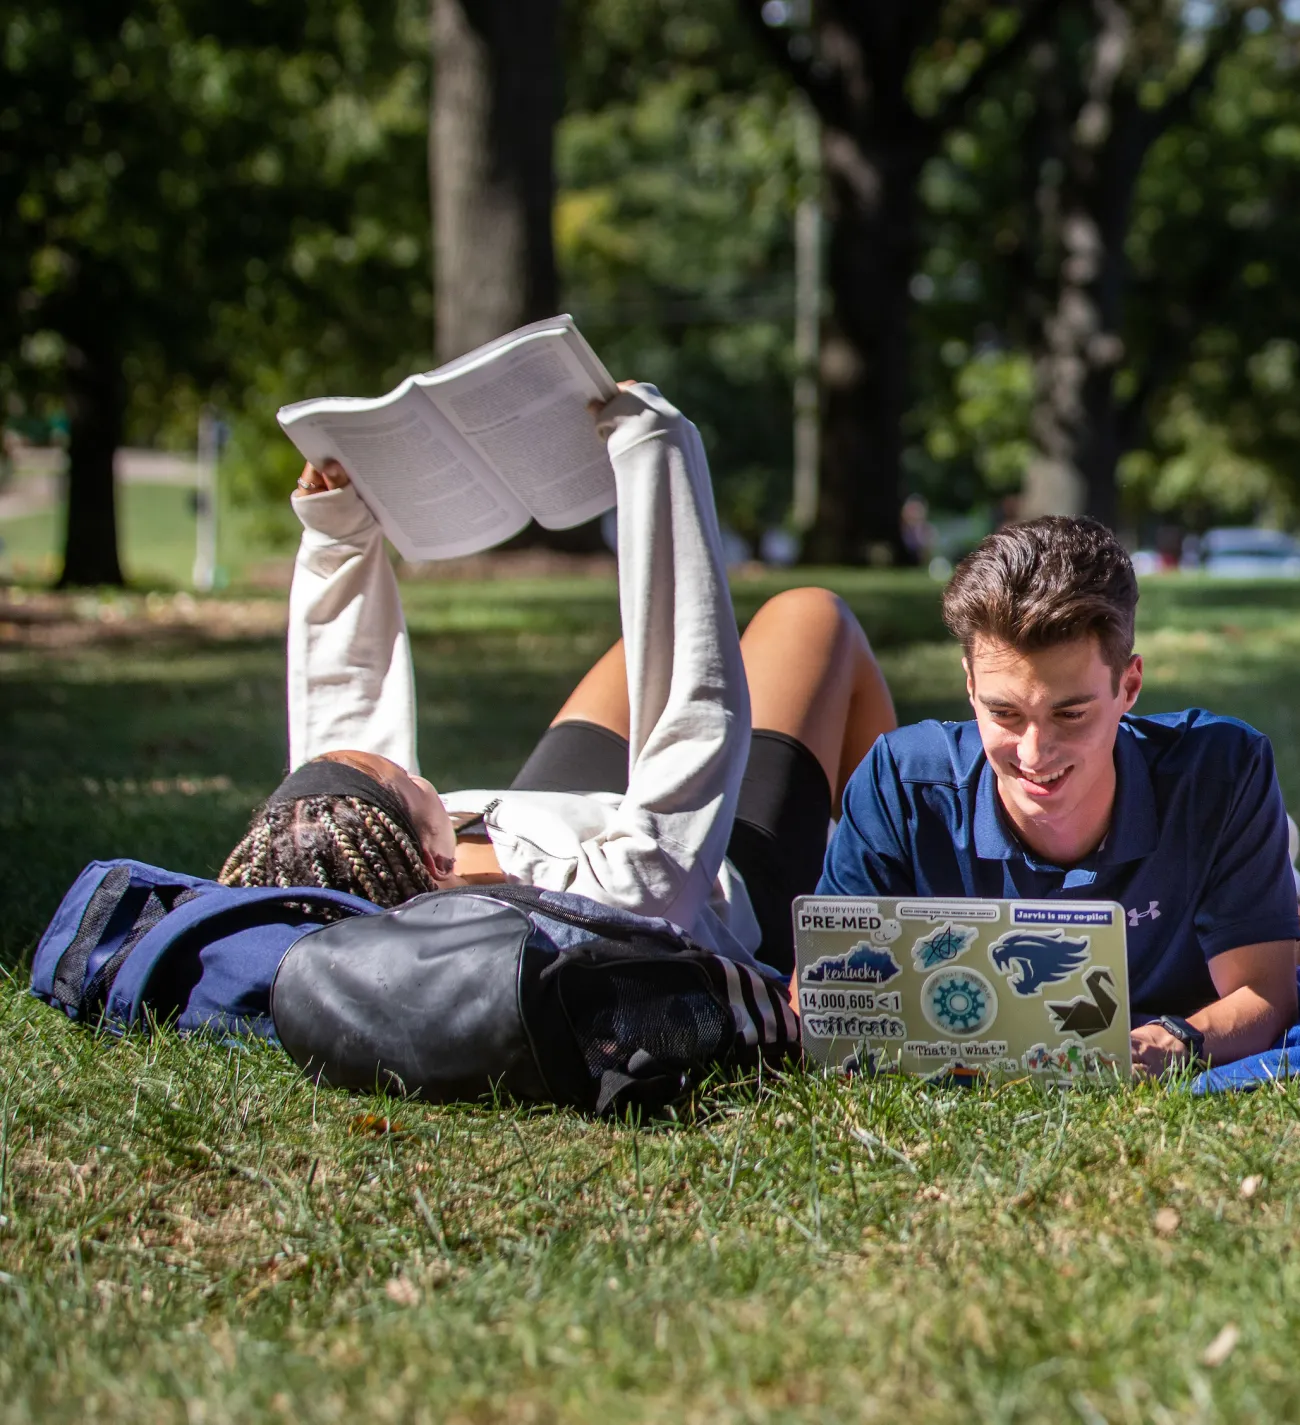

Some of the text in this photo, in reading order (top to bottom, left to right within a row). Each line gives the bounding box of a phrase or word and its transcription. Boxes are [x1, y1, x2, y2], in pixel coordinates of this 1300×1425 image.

[806, 905, 872, 915] I'M SURVIVING
[1017, 911, 1045, 919] Jarvis
[1057, 913, 1072, 921] my
[1074, 913, 1108, 922] co-pilot
[801, 915, 881, 930] PRE-MED
[802, 992, 874, 1011] 14,000,605
[893, 997, 899, 1010] 1
[808, 1017, 905, 1036] wildcats
[907, 1044, 1005, 1056] "That's what."
